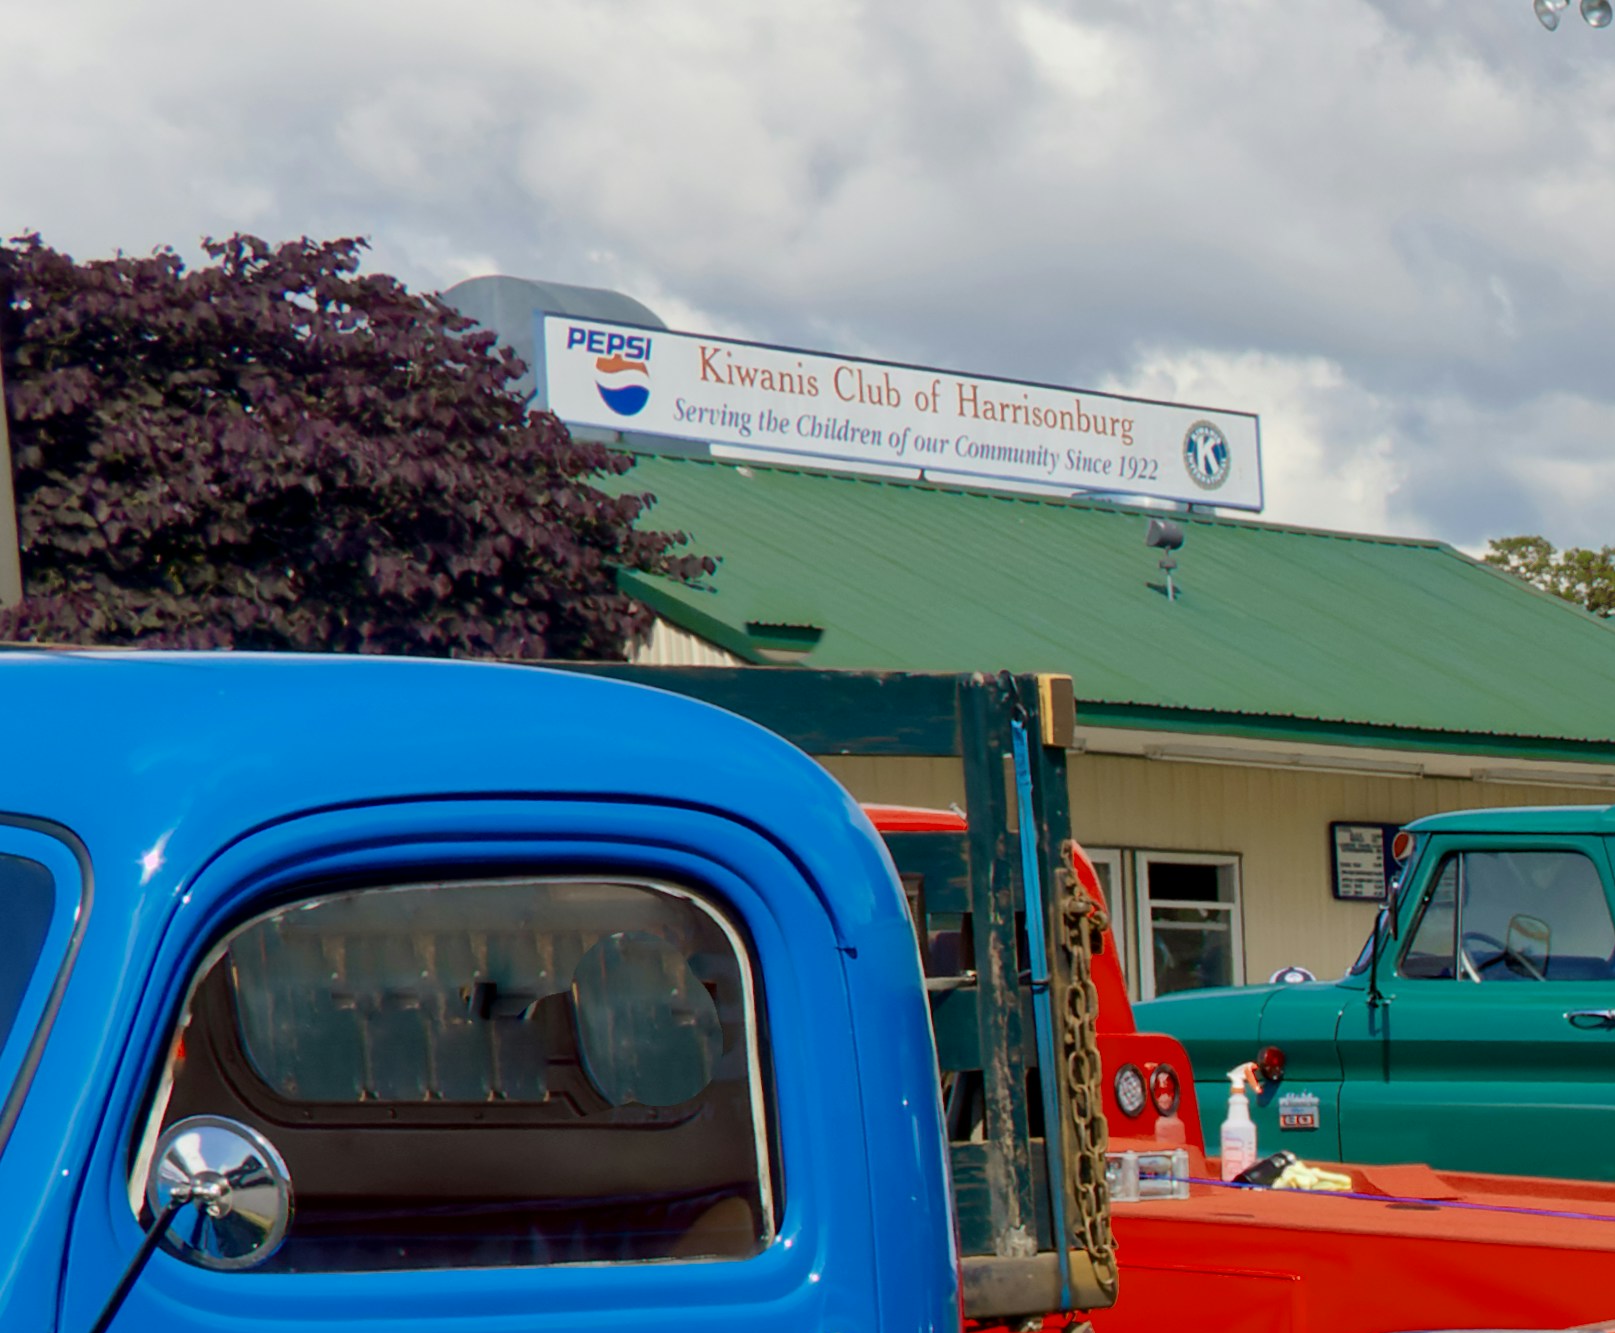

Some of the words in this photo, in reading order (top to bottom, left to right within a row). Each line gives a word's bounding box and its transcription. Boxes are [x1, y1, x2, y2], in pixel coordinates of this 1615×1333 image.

[567, 326, 652, 361] PEPSI
[699, 345, 820, 398] Kiwanis
[833, 366, 902, 408] Club
[914, 378, 941, 413] of
[956, 382, 1135, 446] Harrisonburg
[673, 397, 752, 438] Serving
[758, 408, 790, 434] the
[796, 413, 882, 447] Children
[888, 427, 911, 457] of
[914, 435, 950, 455] our
[955, 434, 1060, 475] Community
[1064, 449, 1112, 476] Since
[1118, 455, 1159, 481] 1922
